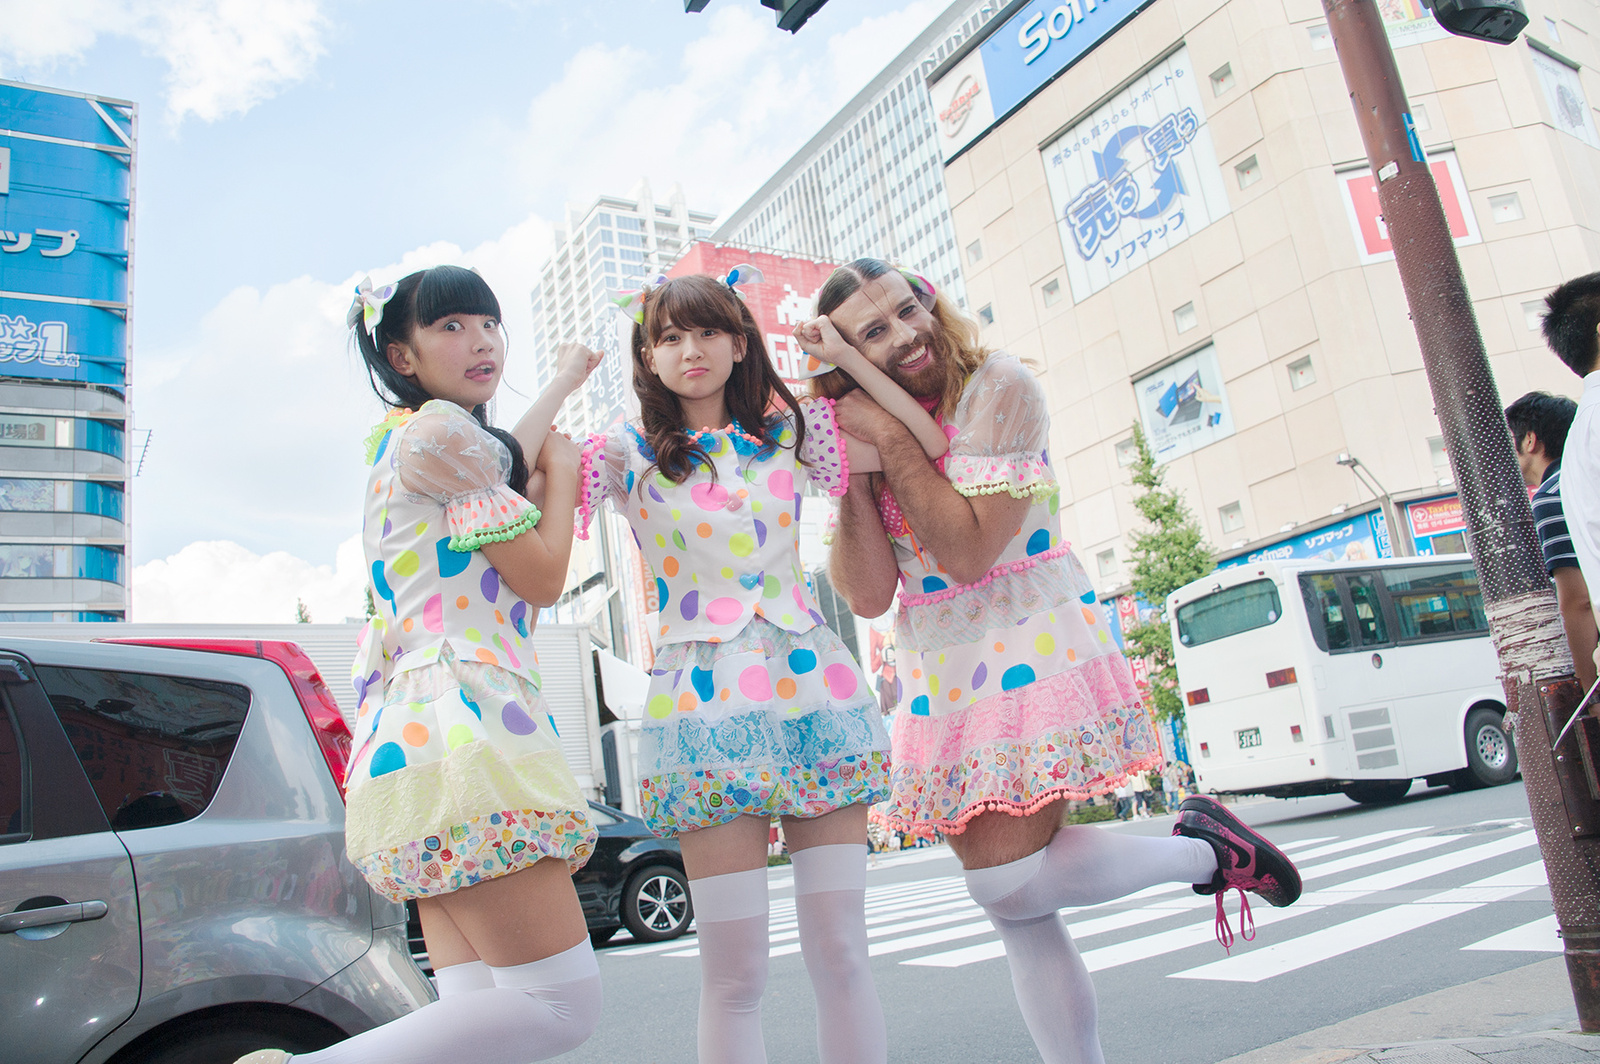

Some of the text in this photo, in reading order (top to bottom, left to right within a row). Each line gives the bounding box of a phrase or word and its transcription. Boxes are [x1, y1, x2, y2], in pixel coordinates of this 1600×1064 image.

[1142, 106, 1199, 174] 買う
[1065, 168, 1141, 261] 売る
[1105, 208, 1186, 269] ソフマップ
[1247, 544, 1293, 563] Sofmap
[1304, 523, 1354, 549] ソフマップ
